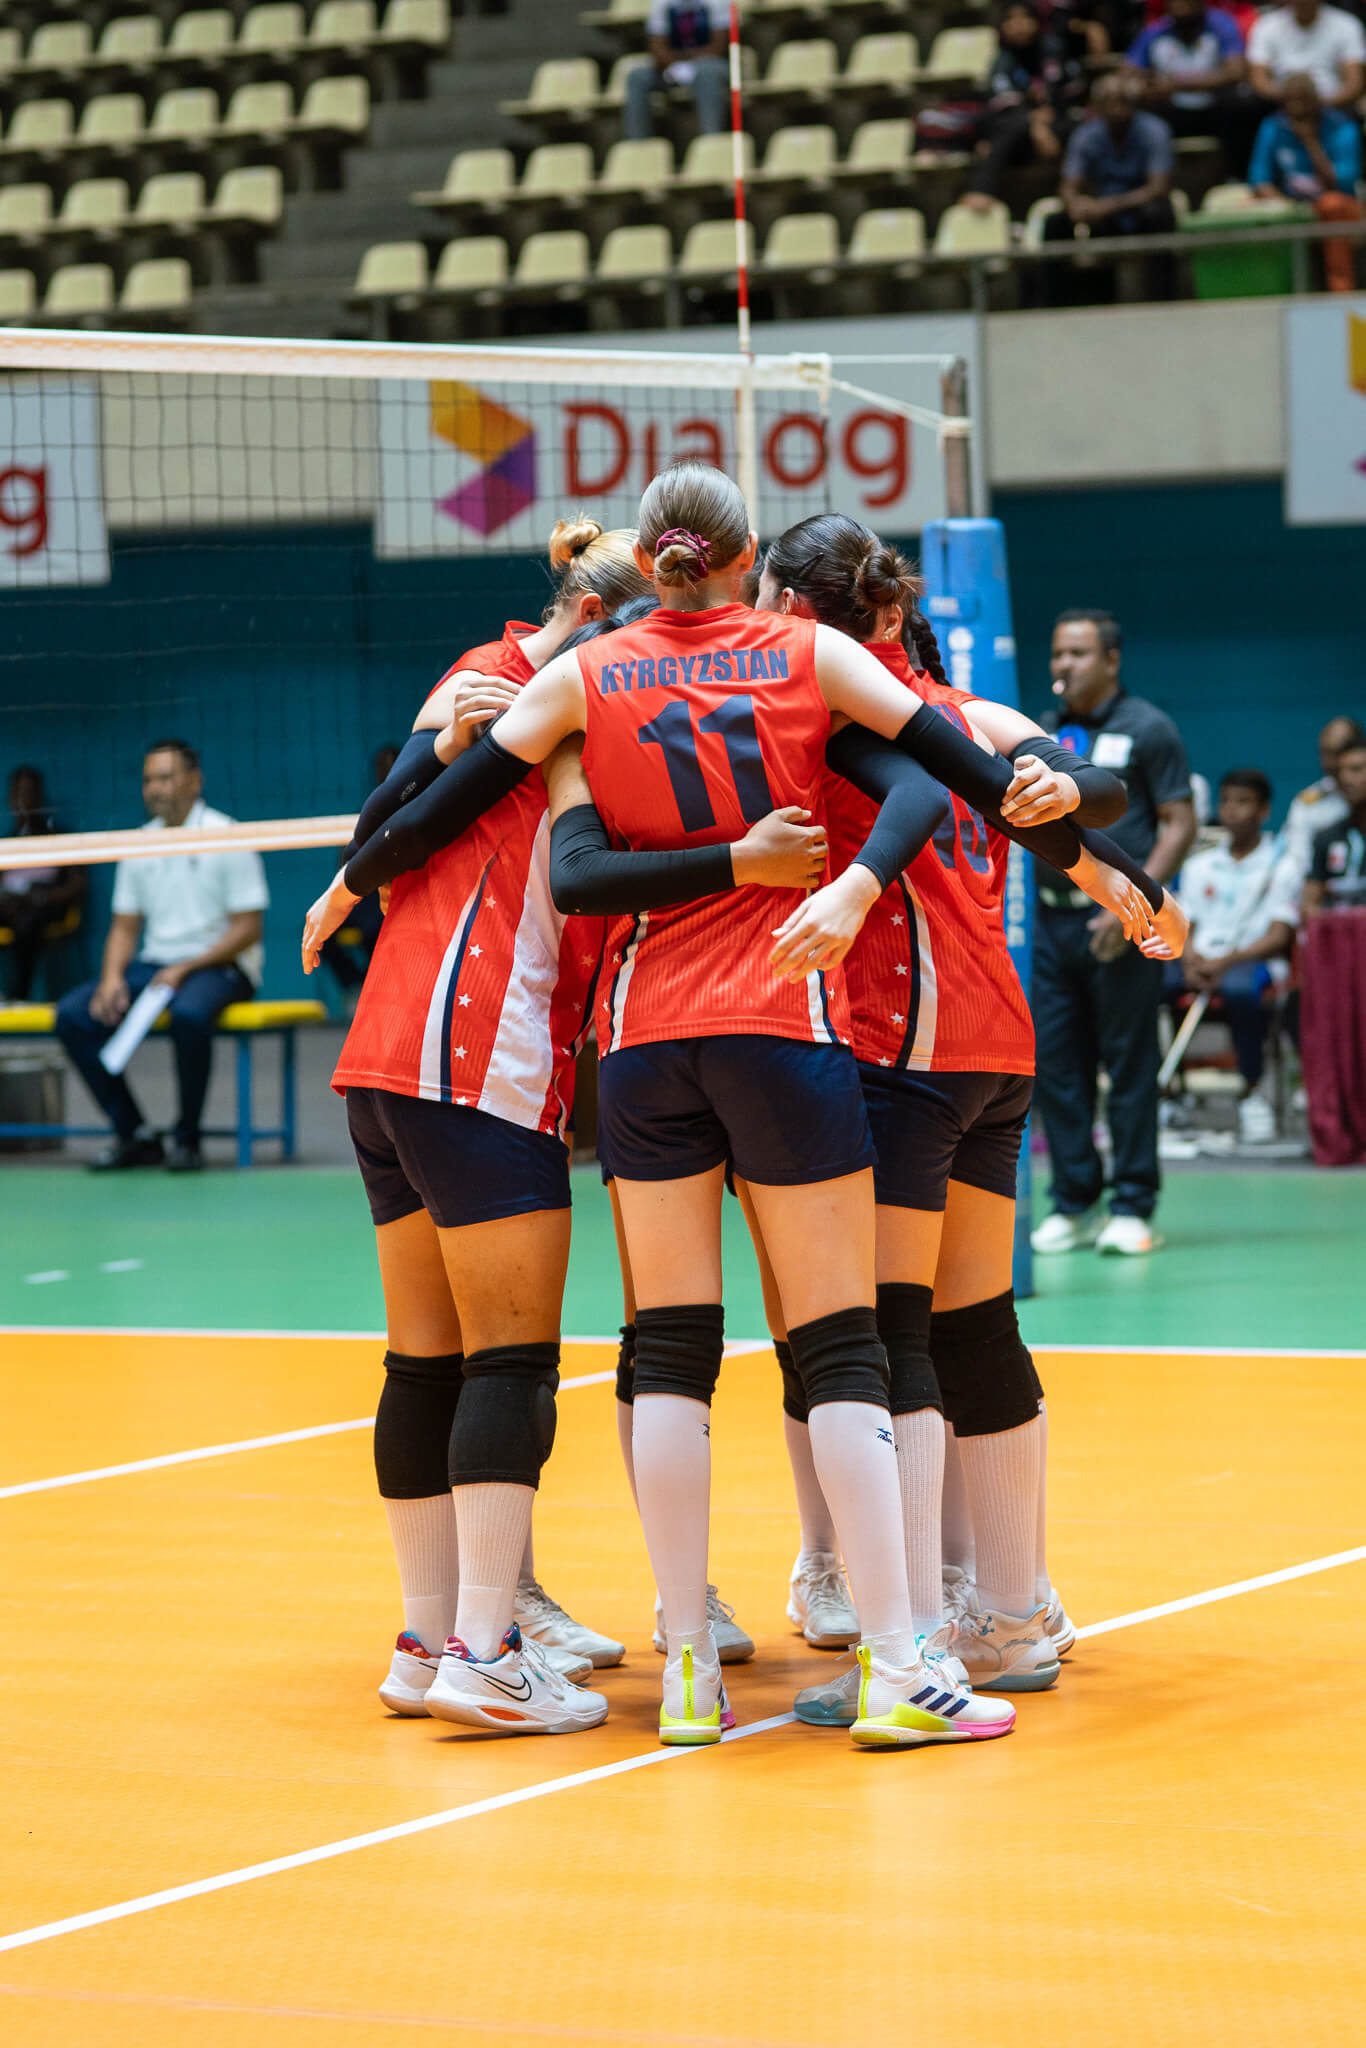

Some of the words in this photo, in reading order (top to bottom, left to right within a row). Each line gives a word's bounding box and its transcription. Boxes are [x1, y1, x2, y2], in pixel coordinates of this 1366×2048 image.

[563, 400, 911, 508] Diaog
[601, 649, 789, 694] KYRGYZSTAN
[638, 694, 774, 833] 11
